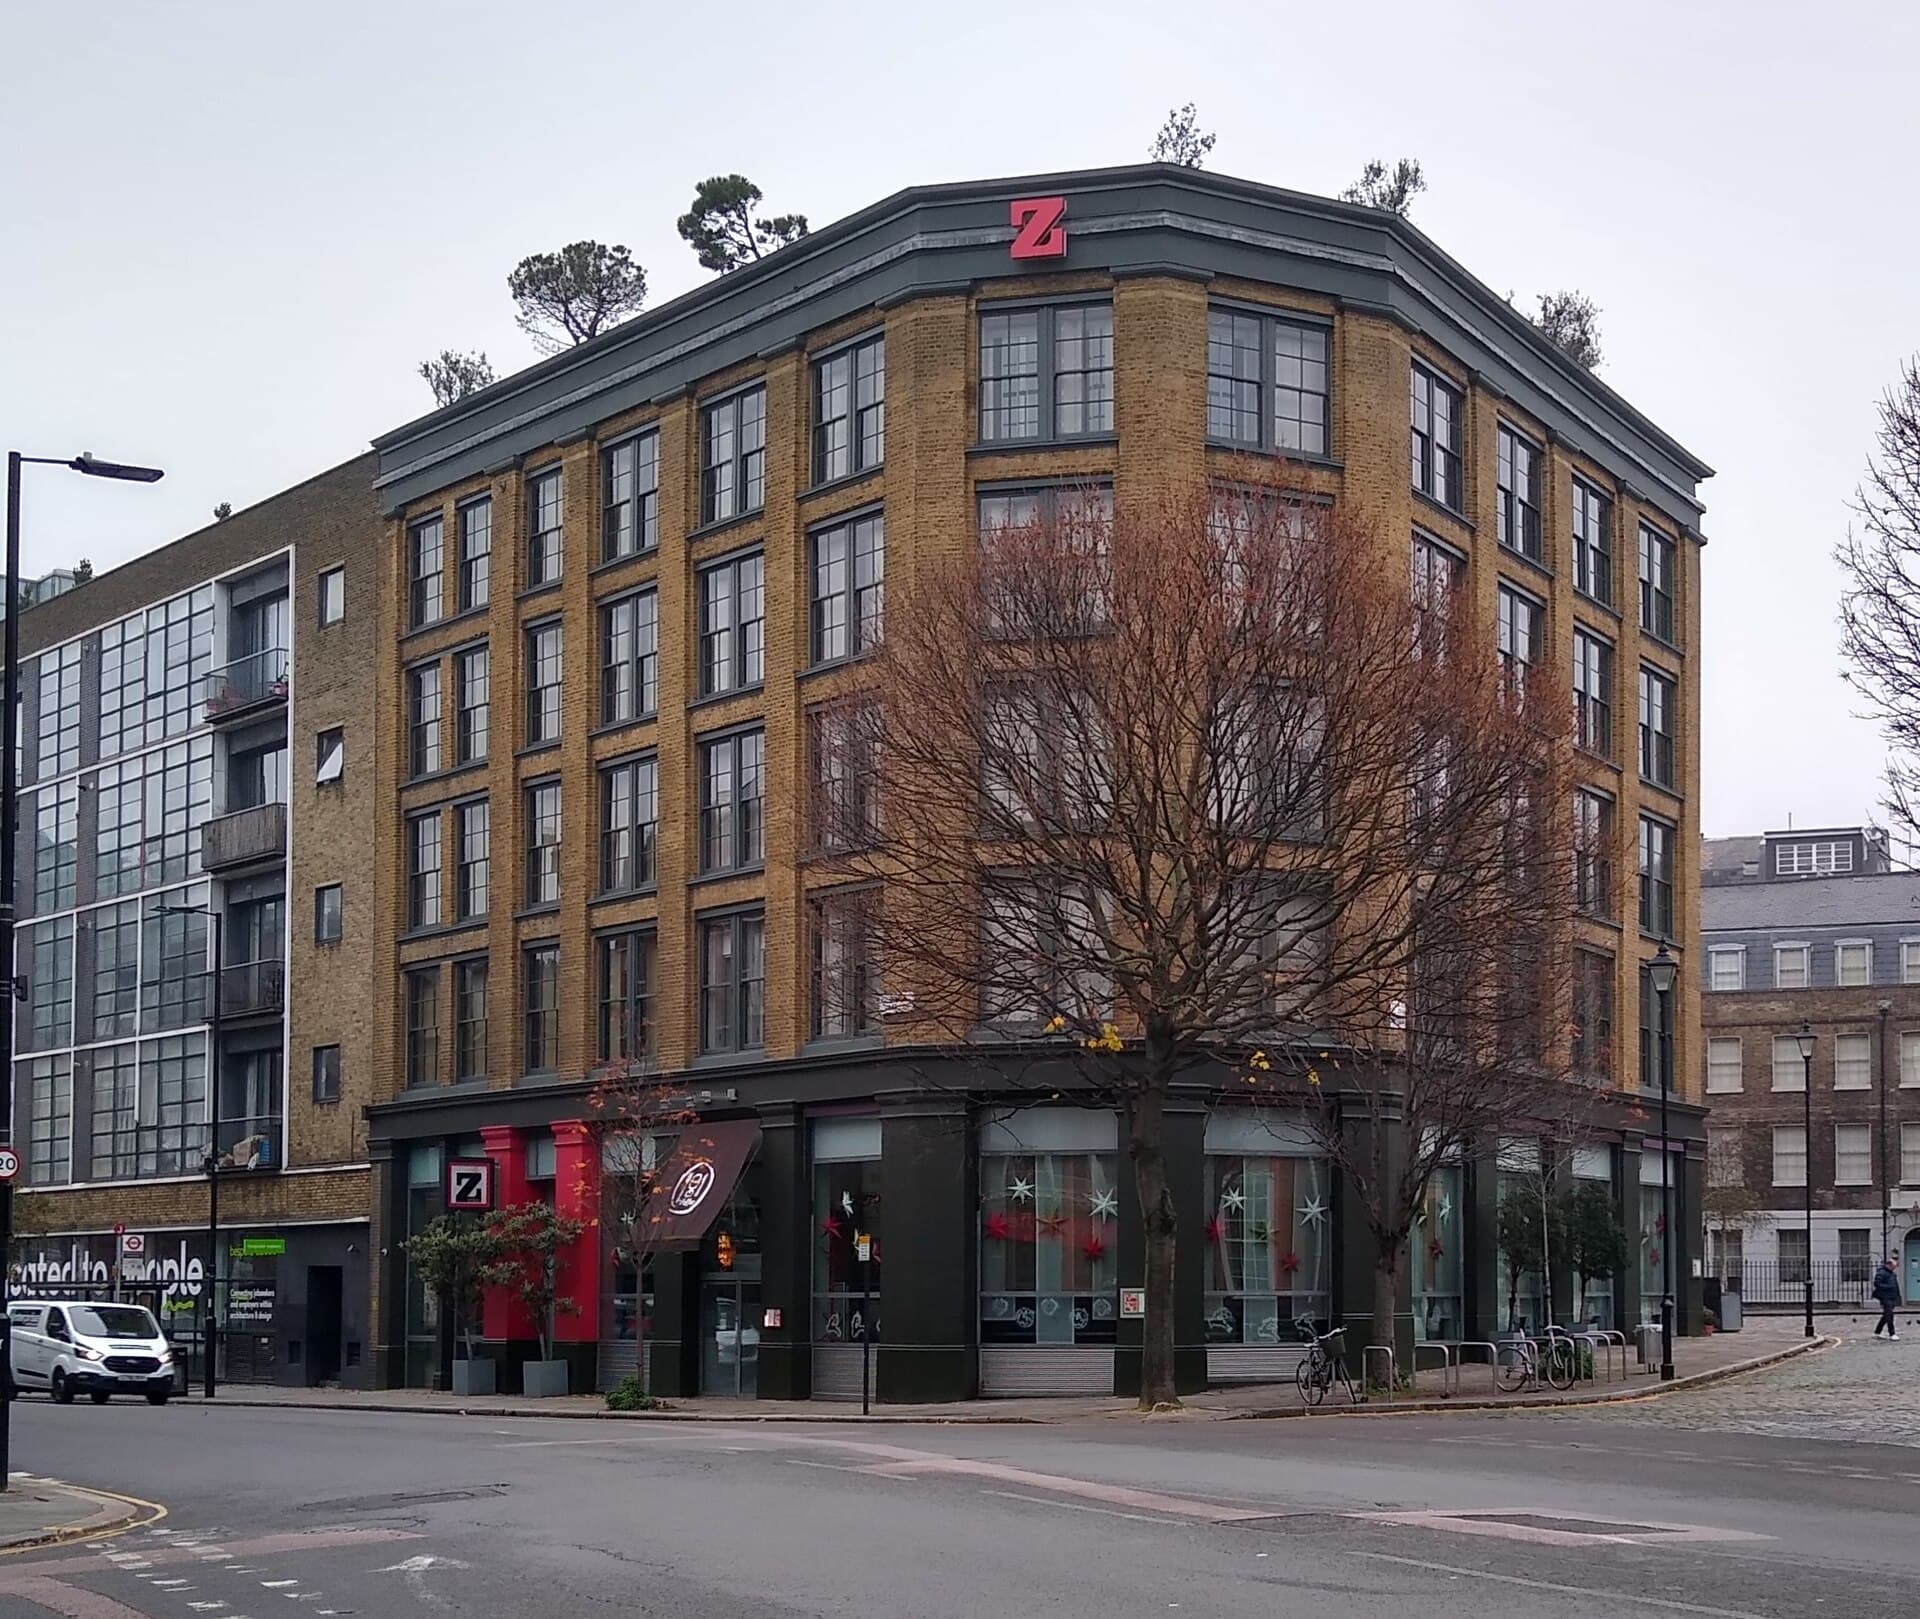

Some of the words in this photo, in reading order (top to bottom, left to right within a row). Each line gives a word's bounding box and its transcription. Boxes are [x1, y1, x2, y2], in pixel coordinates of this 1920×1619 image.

[1010, 197, 1067, 259] Z
[455, 1172, 482, 1202] Z
[113, 1240, 204, 1310] ople
